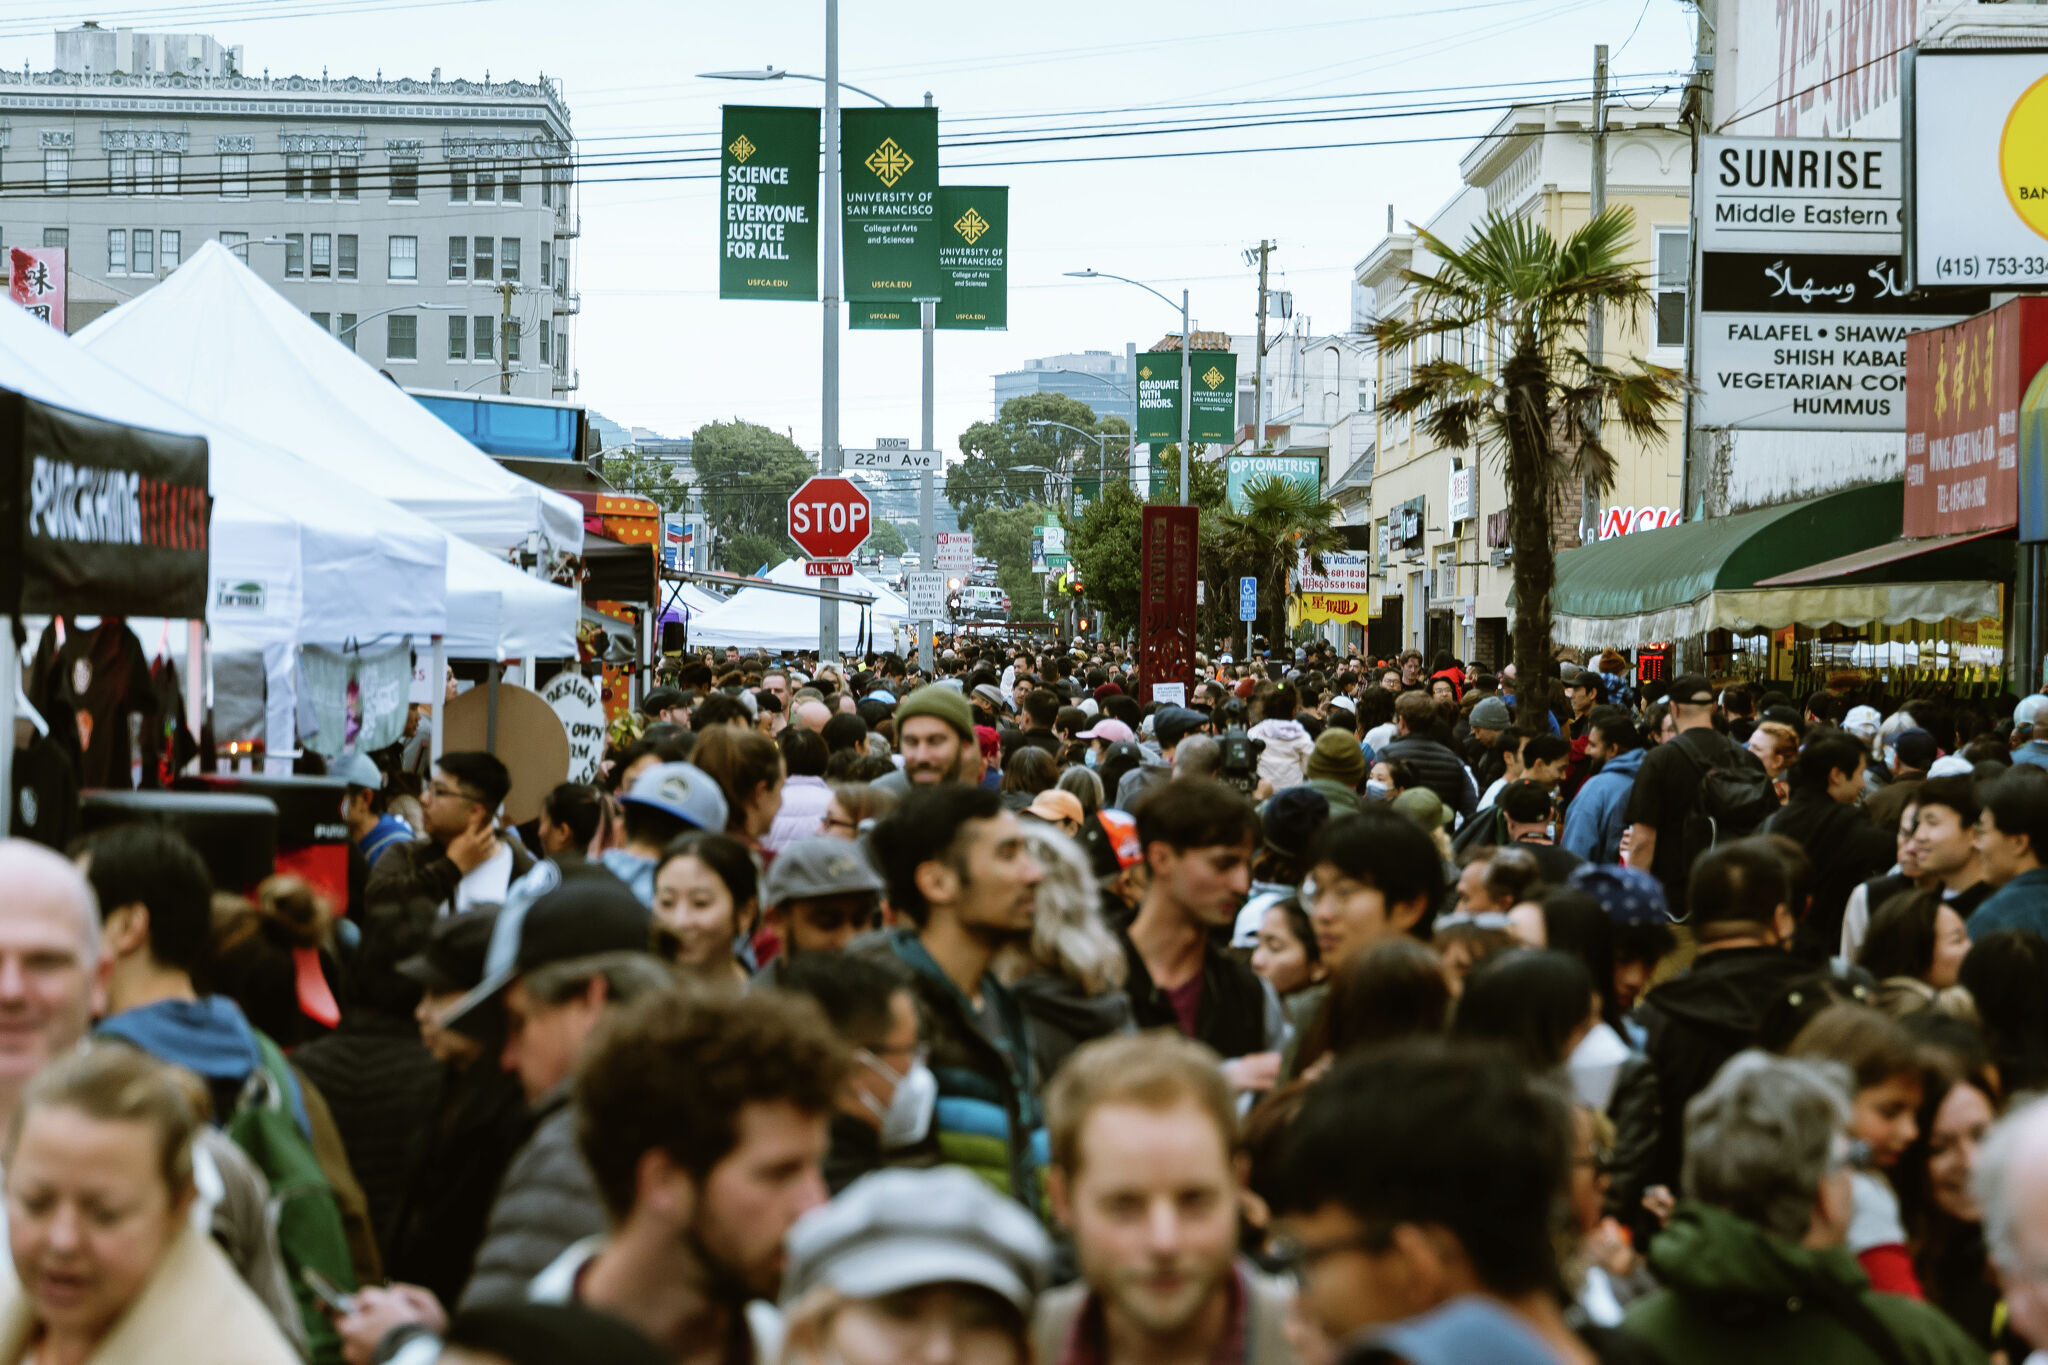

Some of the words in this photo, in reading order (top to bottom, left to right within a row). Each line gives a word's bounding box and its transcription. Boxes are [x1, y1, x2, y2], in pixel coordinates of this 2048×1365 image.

[1719, 148, 1882, 189] SUNRISE
[727, 165, 789, 185] SCIENCE
[727, 185, 757, 202] FOR
[846, 192, 914, 203] UNIVERSITY
[918, 192, 933, 203] OF
[727, 203, 809, 223] EVERYONE.
[846, 205, 869, 215] SAN
[872, 205, 933, 216] FRANCISCO
[1715, 203, 1796, 224] Middle
[1804, 204, 1888, 225] Eastern
[726, 222, 785, 241] JUSTICE
[863, 224, 890, 234] College
[892, 224, 900, 232] of
[901, 224, 918, 233] Arts
[867, 236, 881, 244] and
[882, 236, 915, 245] Sciences
[726, 241, 756, 259] FOR
[758, 242, 789, 260] ALL.
[940, 247, 989, 257] UNIVERSITY
[992, 248, 1003, 257] OF
[940, 257, 956, 266] SAN
[958, 257, 1003, 266] FRANCISCO
[1936, 255, 1980, 280] (415)
[952, 271, 971, 280] College
[978, 271, 990, 279] Arts
[747, 278, 789, 287] USFCA.EDU
[871, 281, 912, 289] USFCA.EDU
[1728, 324, 1813, 341] FALAFEL
[1835, 325, 1920, 343] SHAWA
[1774, 349, 1834, 366] SHISH
[1139, 380, 1179, 390] GRADUATE
[1717, 372, 1852, 391] VEGETARIAN
[1139, 390, 1160, 399] WITH
[1139, 399, 1174, 409] HONORS.
[1793, 398, 1891, 416] HUMMUS
[878, 438, 899, 448] 1300
[855, 453, 890, 466] 22nd
[901, 454, 930, 467] Ave
[1929, 436, 1950, 472] WING
[1230, 458, 1317, 475] OPTOMETRIST
[793, 502, 867, 533] STOP
[938, 533, 948, 545] NO
[949, 536, 972, 544] PARKING
[1321, 554, 1333, 565] tar
[808, 564, 827, 575] ALL
[831, 564, 850, 575] WAY
[911, 575, 942, 583] SKATEBOARD
[917, 592, 936, 600] RIDING
[912, 600, 941, 608] PROHIBITED
[546, 678, 596, 708] DESIGN
[571, 723, 603, 741] OWN
